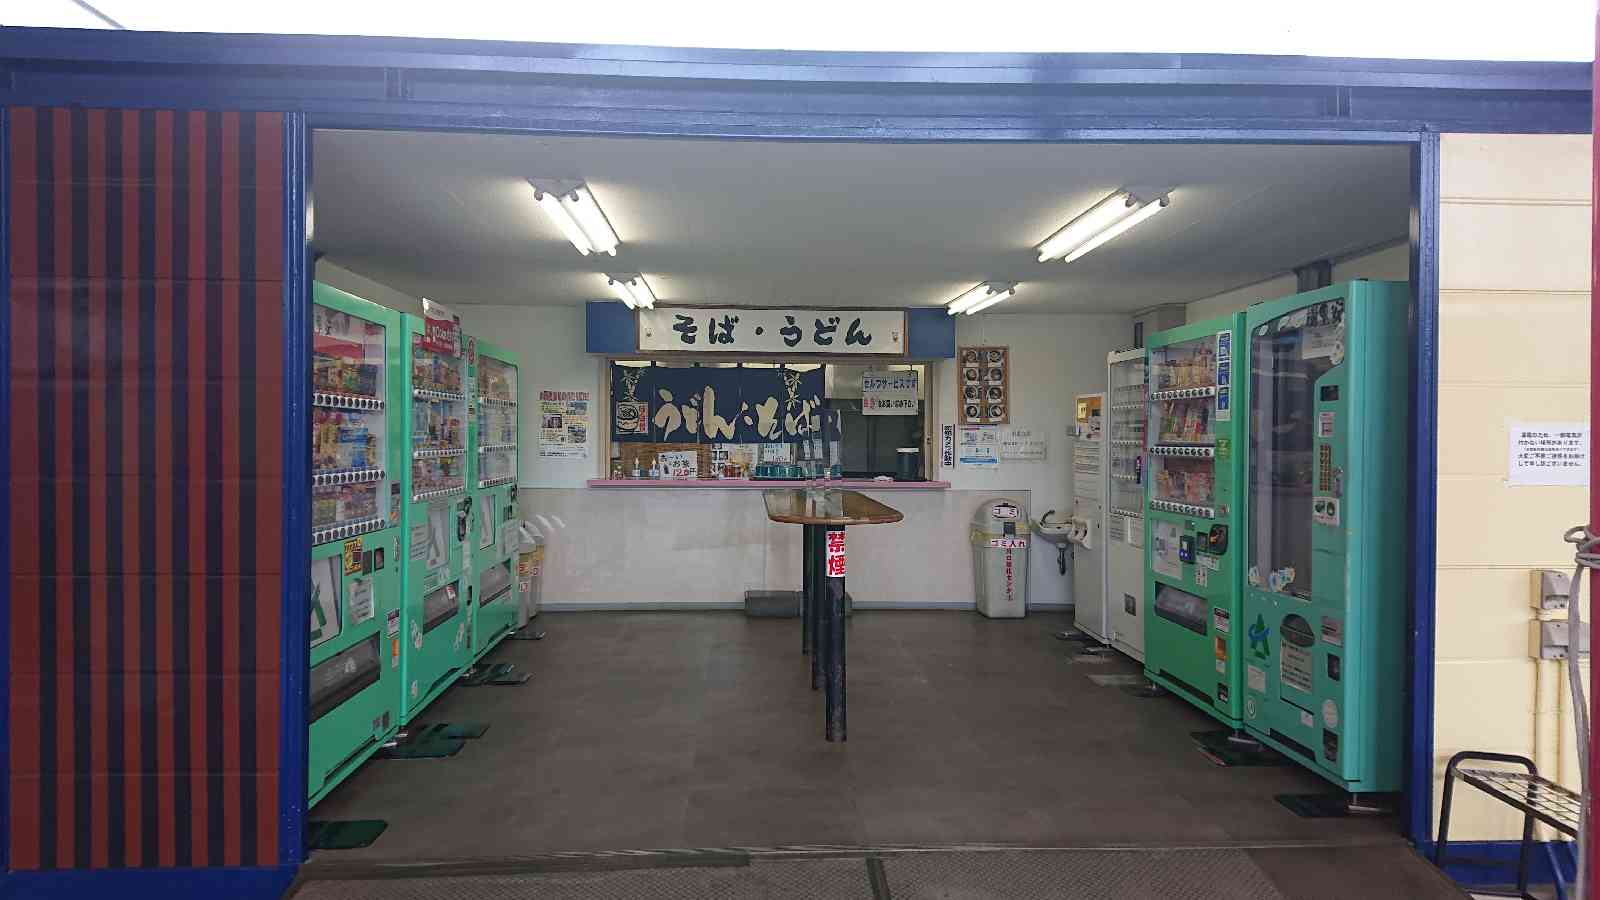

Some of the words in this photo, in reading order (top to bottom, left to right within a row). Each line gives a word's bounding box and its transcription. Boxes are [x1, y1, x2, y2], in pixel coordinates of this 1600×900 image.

[672, 313, 872, 347] そば・うどん
[993, 507, 1016, 516] ゴミ
[828, 531, 846, 575] 禁煙
